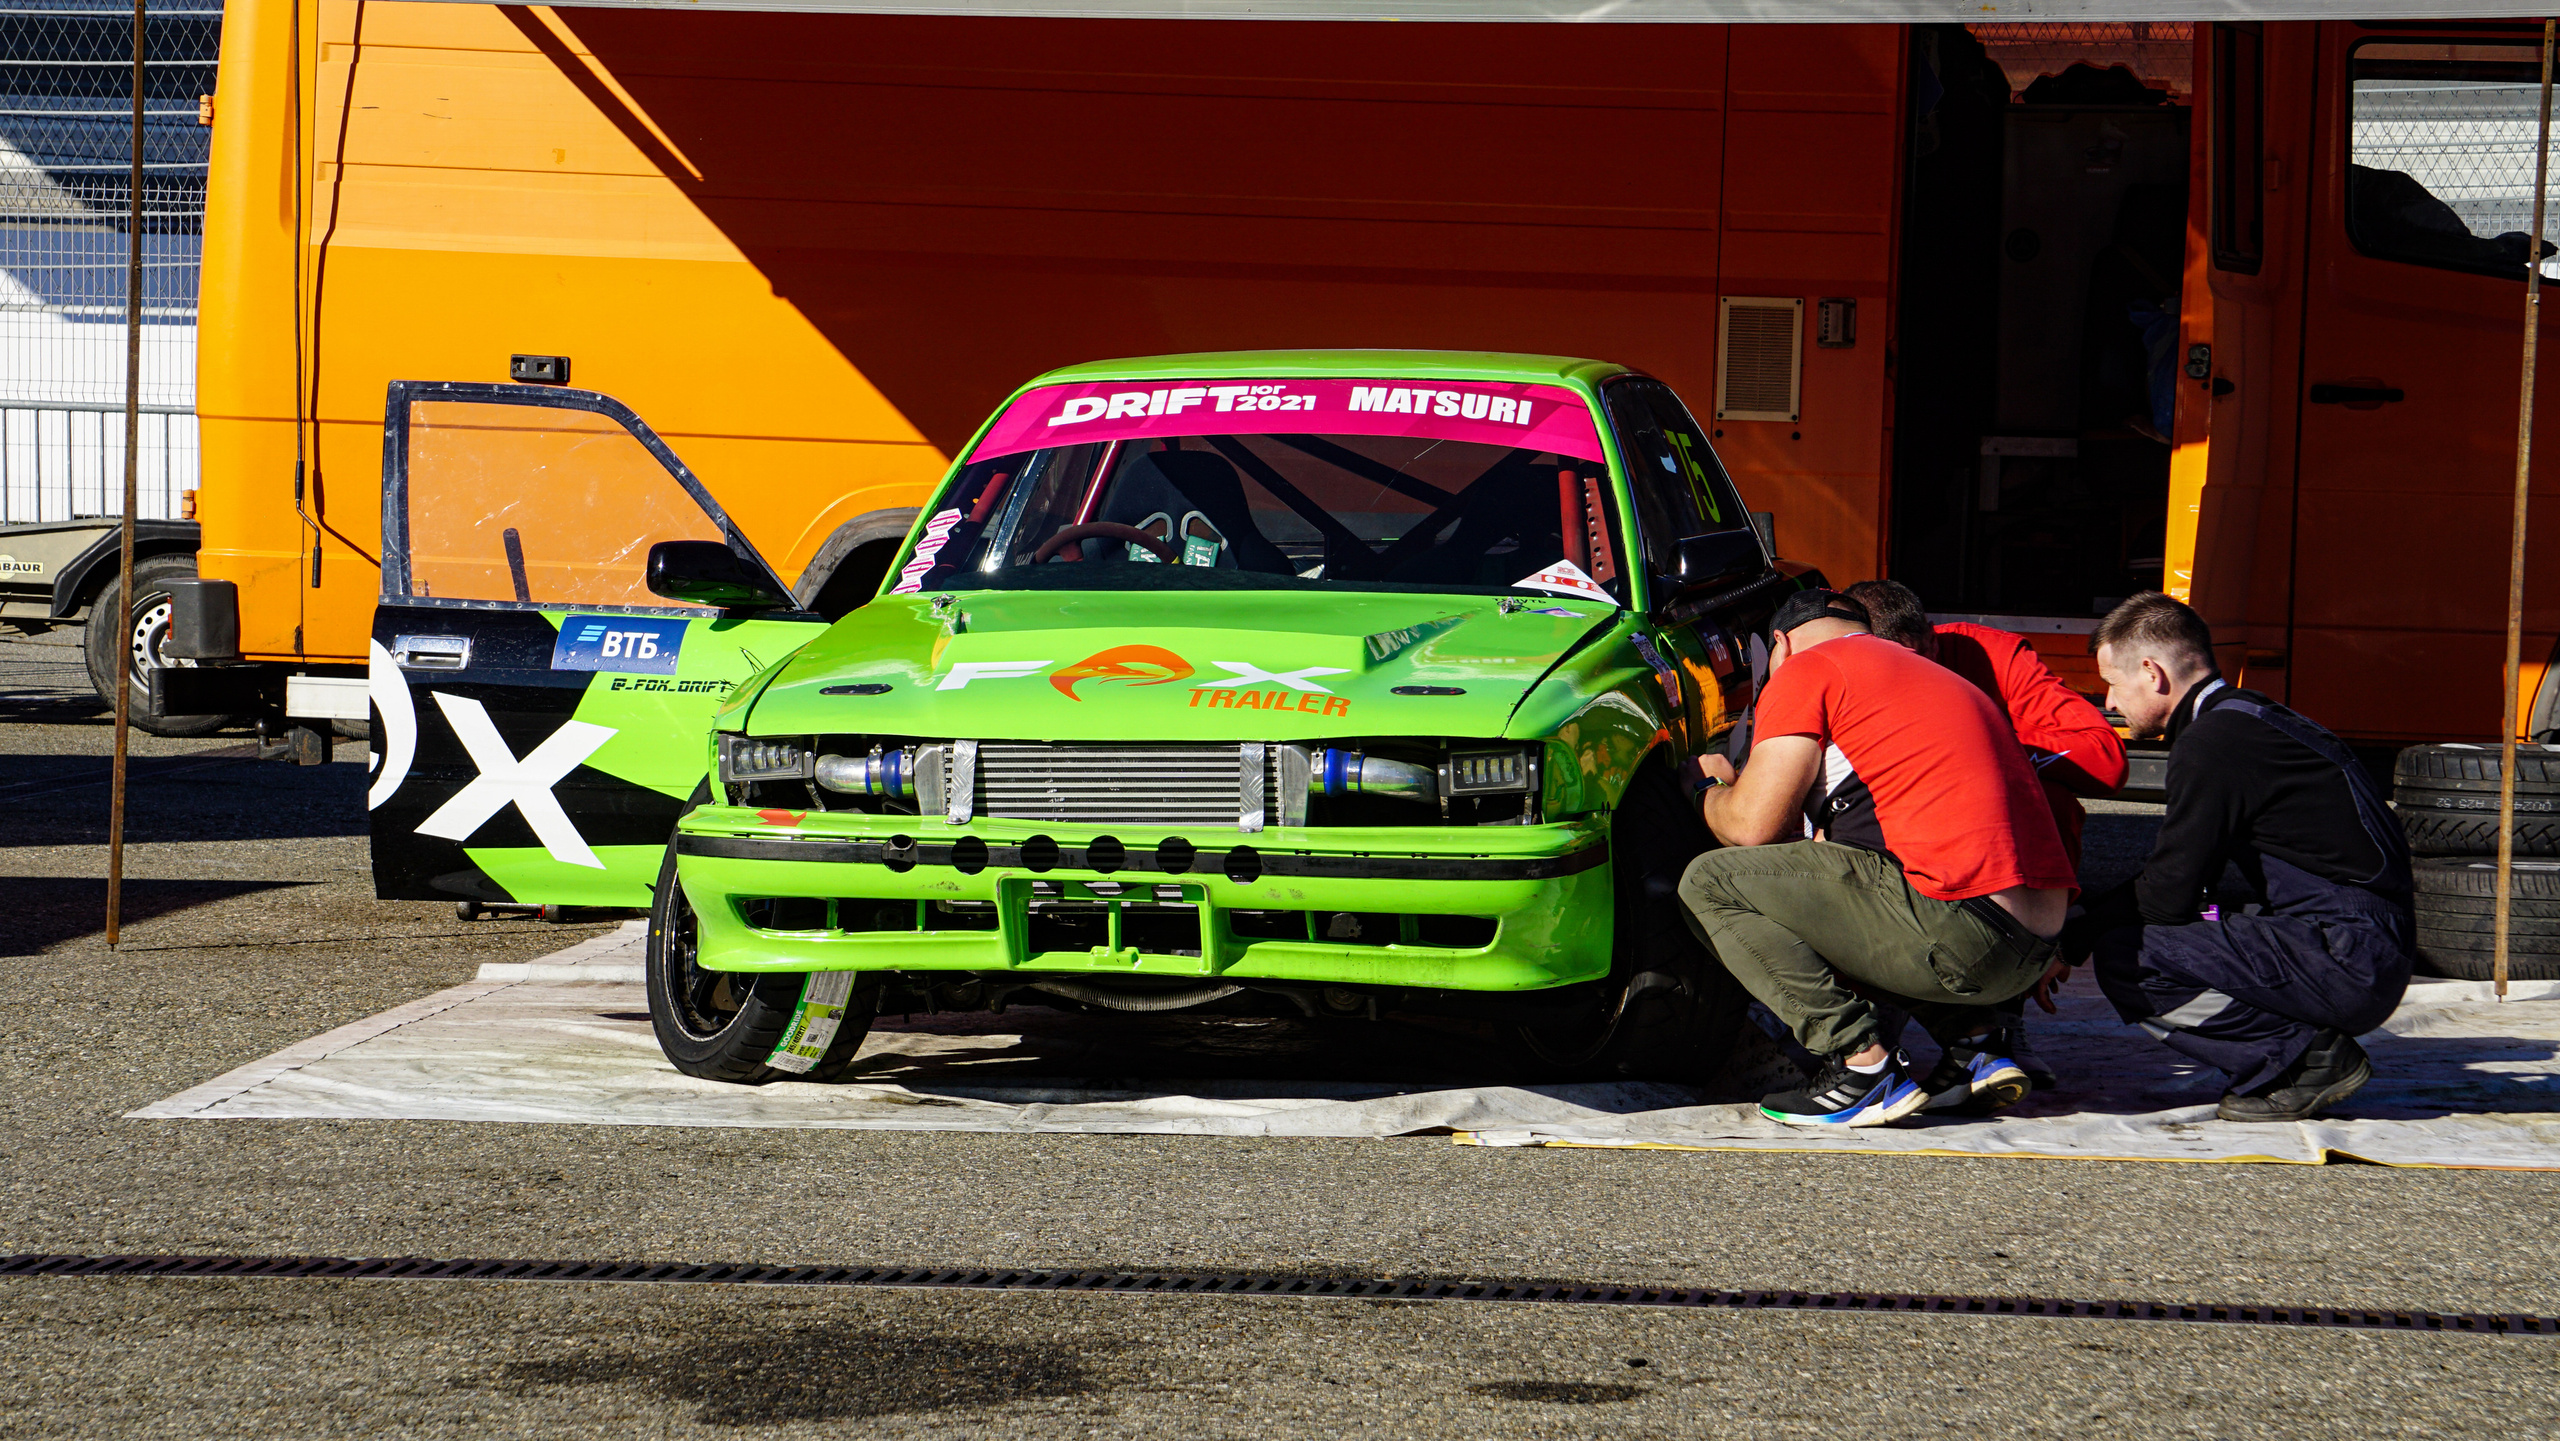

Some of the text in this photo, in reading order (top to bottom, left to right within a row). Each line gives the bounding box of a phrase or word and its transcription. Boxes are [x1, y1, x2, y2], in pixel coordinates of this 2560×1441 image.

[1047, 386, 1532, 427] DRIFT 2021 MATSURI
[1664, 429, 1720, 523] 75
[0, 562, 41, 571] BAUR
[601, 631, 660, 659] ВТБ
[1188, 688, 1352, 717] TRAILER
[780, 1009, 804, 1047] GOODRIDE
